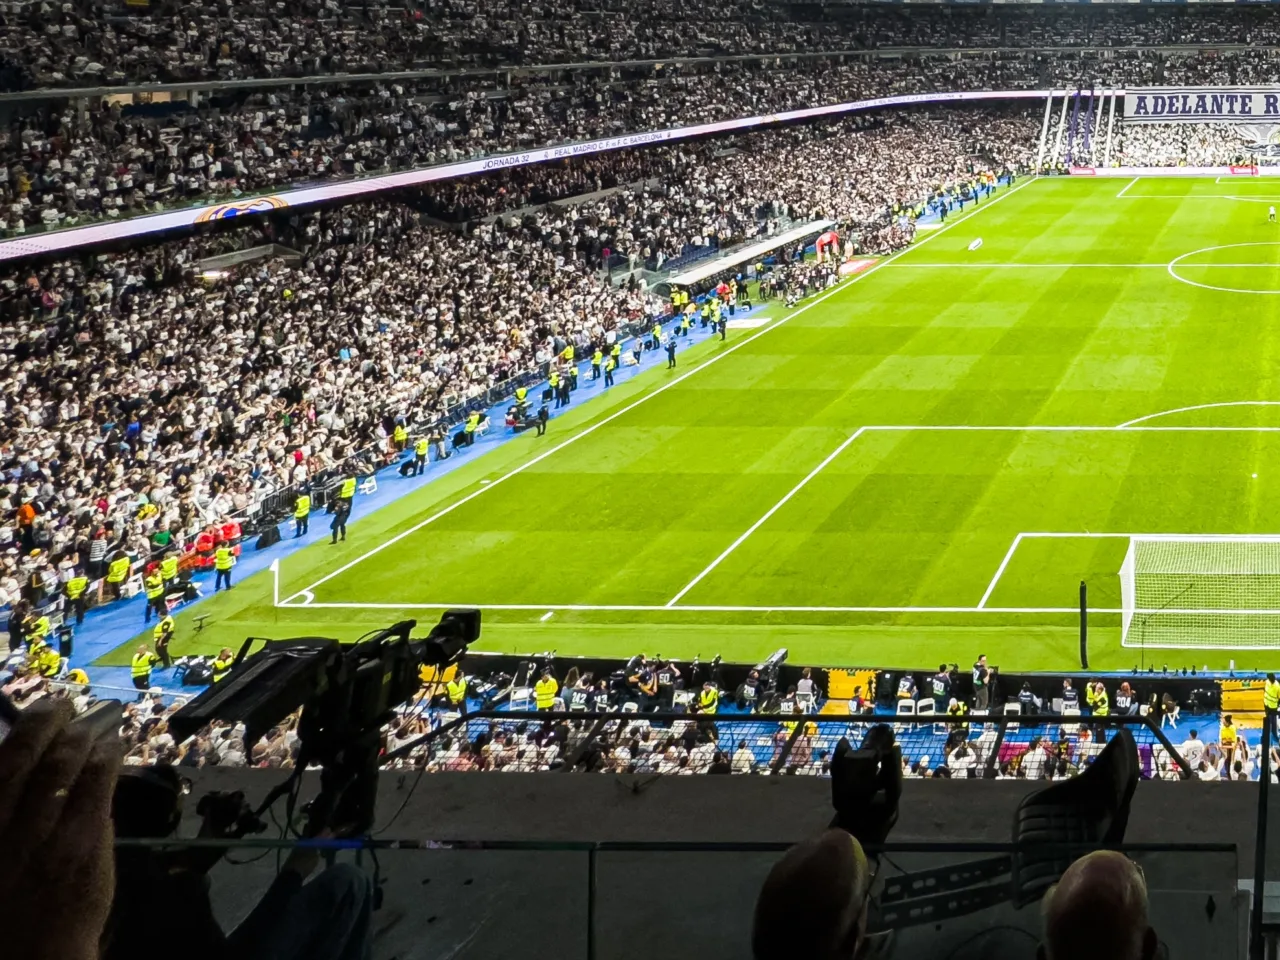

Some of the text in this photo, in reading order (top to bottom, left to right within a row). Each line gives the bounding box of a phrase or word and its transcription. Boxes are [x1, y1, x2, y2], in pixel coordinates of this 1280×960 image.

[1134, 95, 1252, 115] ADELANTE
[554, 147, 571, 157] REAL
[573, 143, 598, 155] MADRID
[630, 133, 663, 143] BARCELONA
[482, 155, 530, 170] JORNADA 32
[1116, 696, 1131, 708] 204
